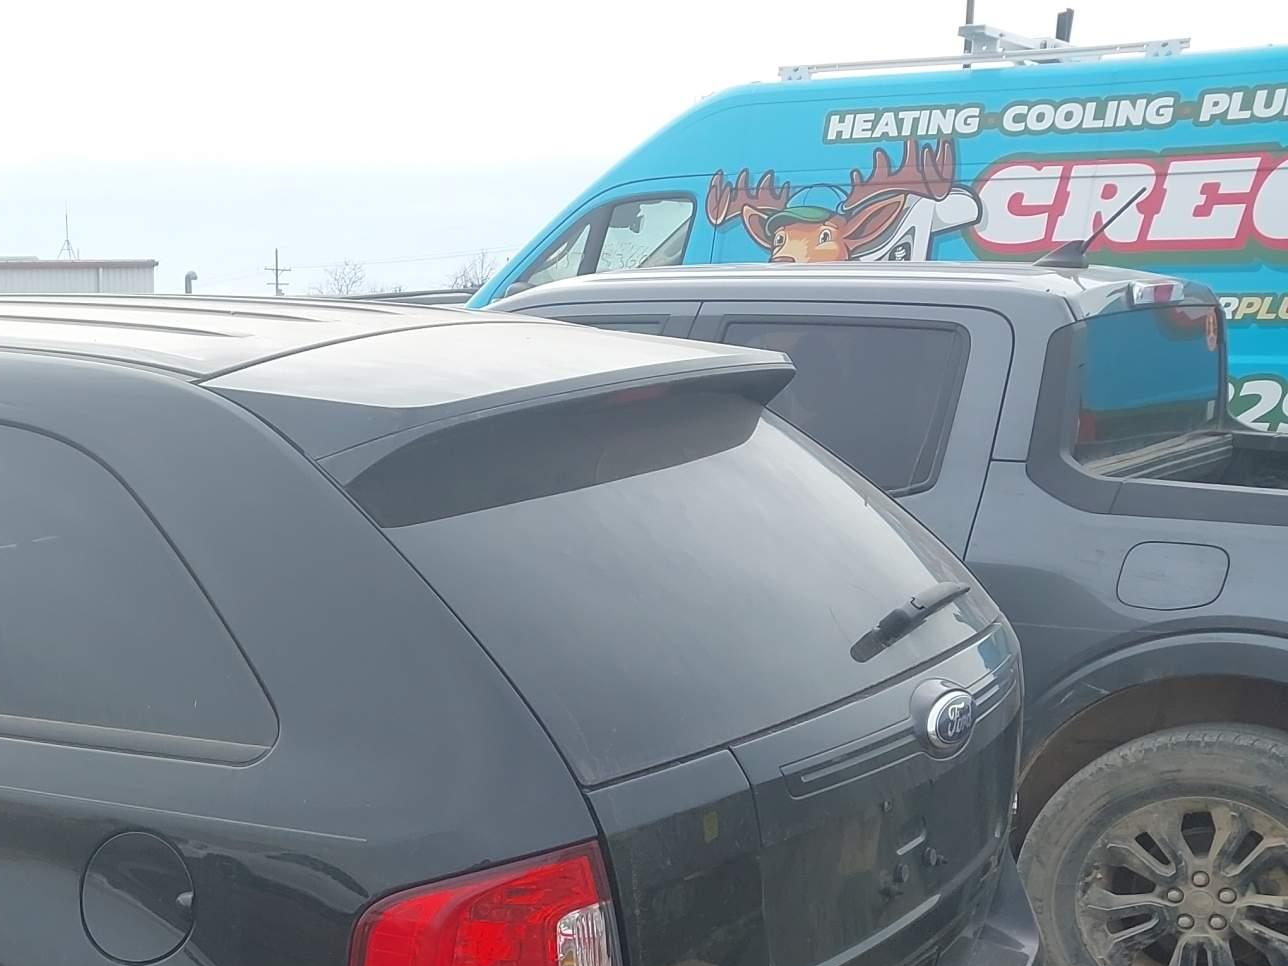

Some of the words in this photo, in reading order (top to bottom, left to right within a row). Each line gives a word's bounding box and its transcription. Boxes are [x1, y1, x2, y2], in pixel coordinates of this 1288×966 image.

[827, 107, 981, 140] HEATING
[1003, 96, 1175, 132] COOLING
[1199, 88, 1288, 122] PLU
